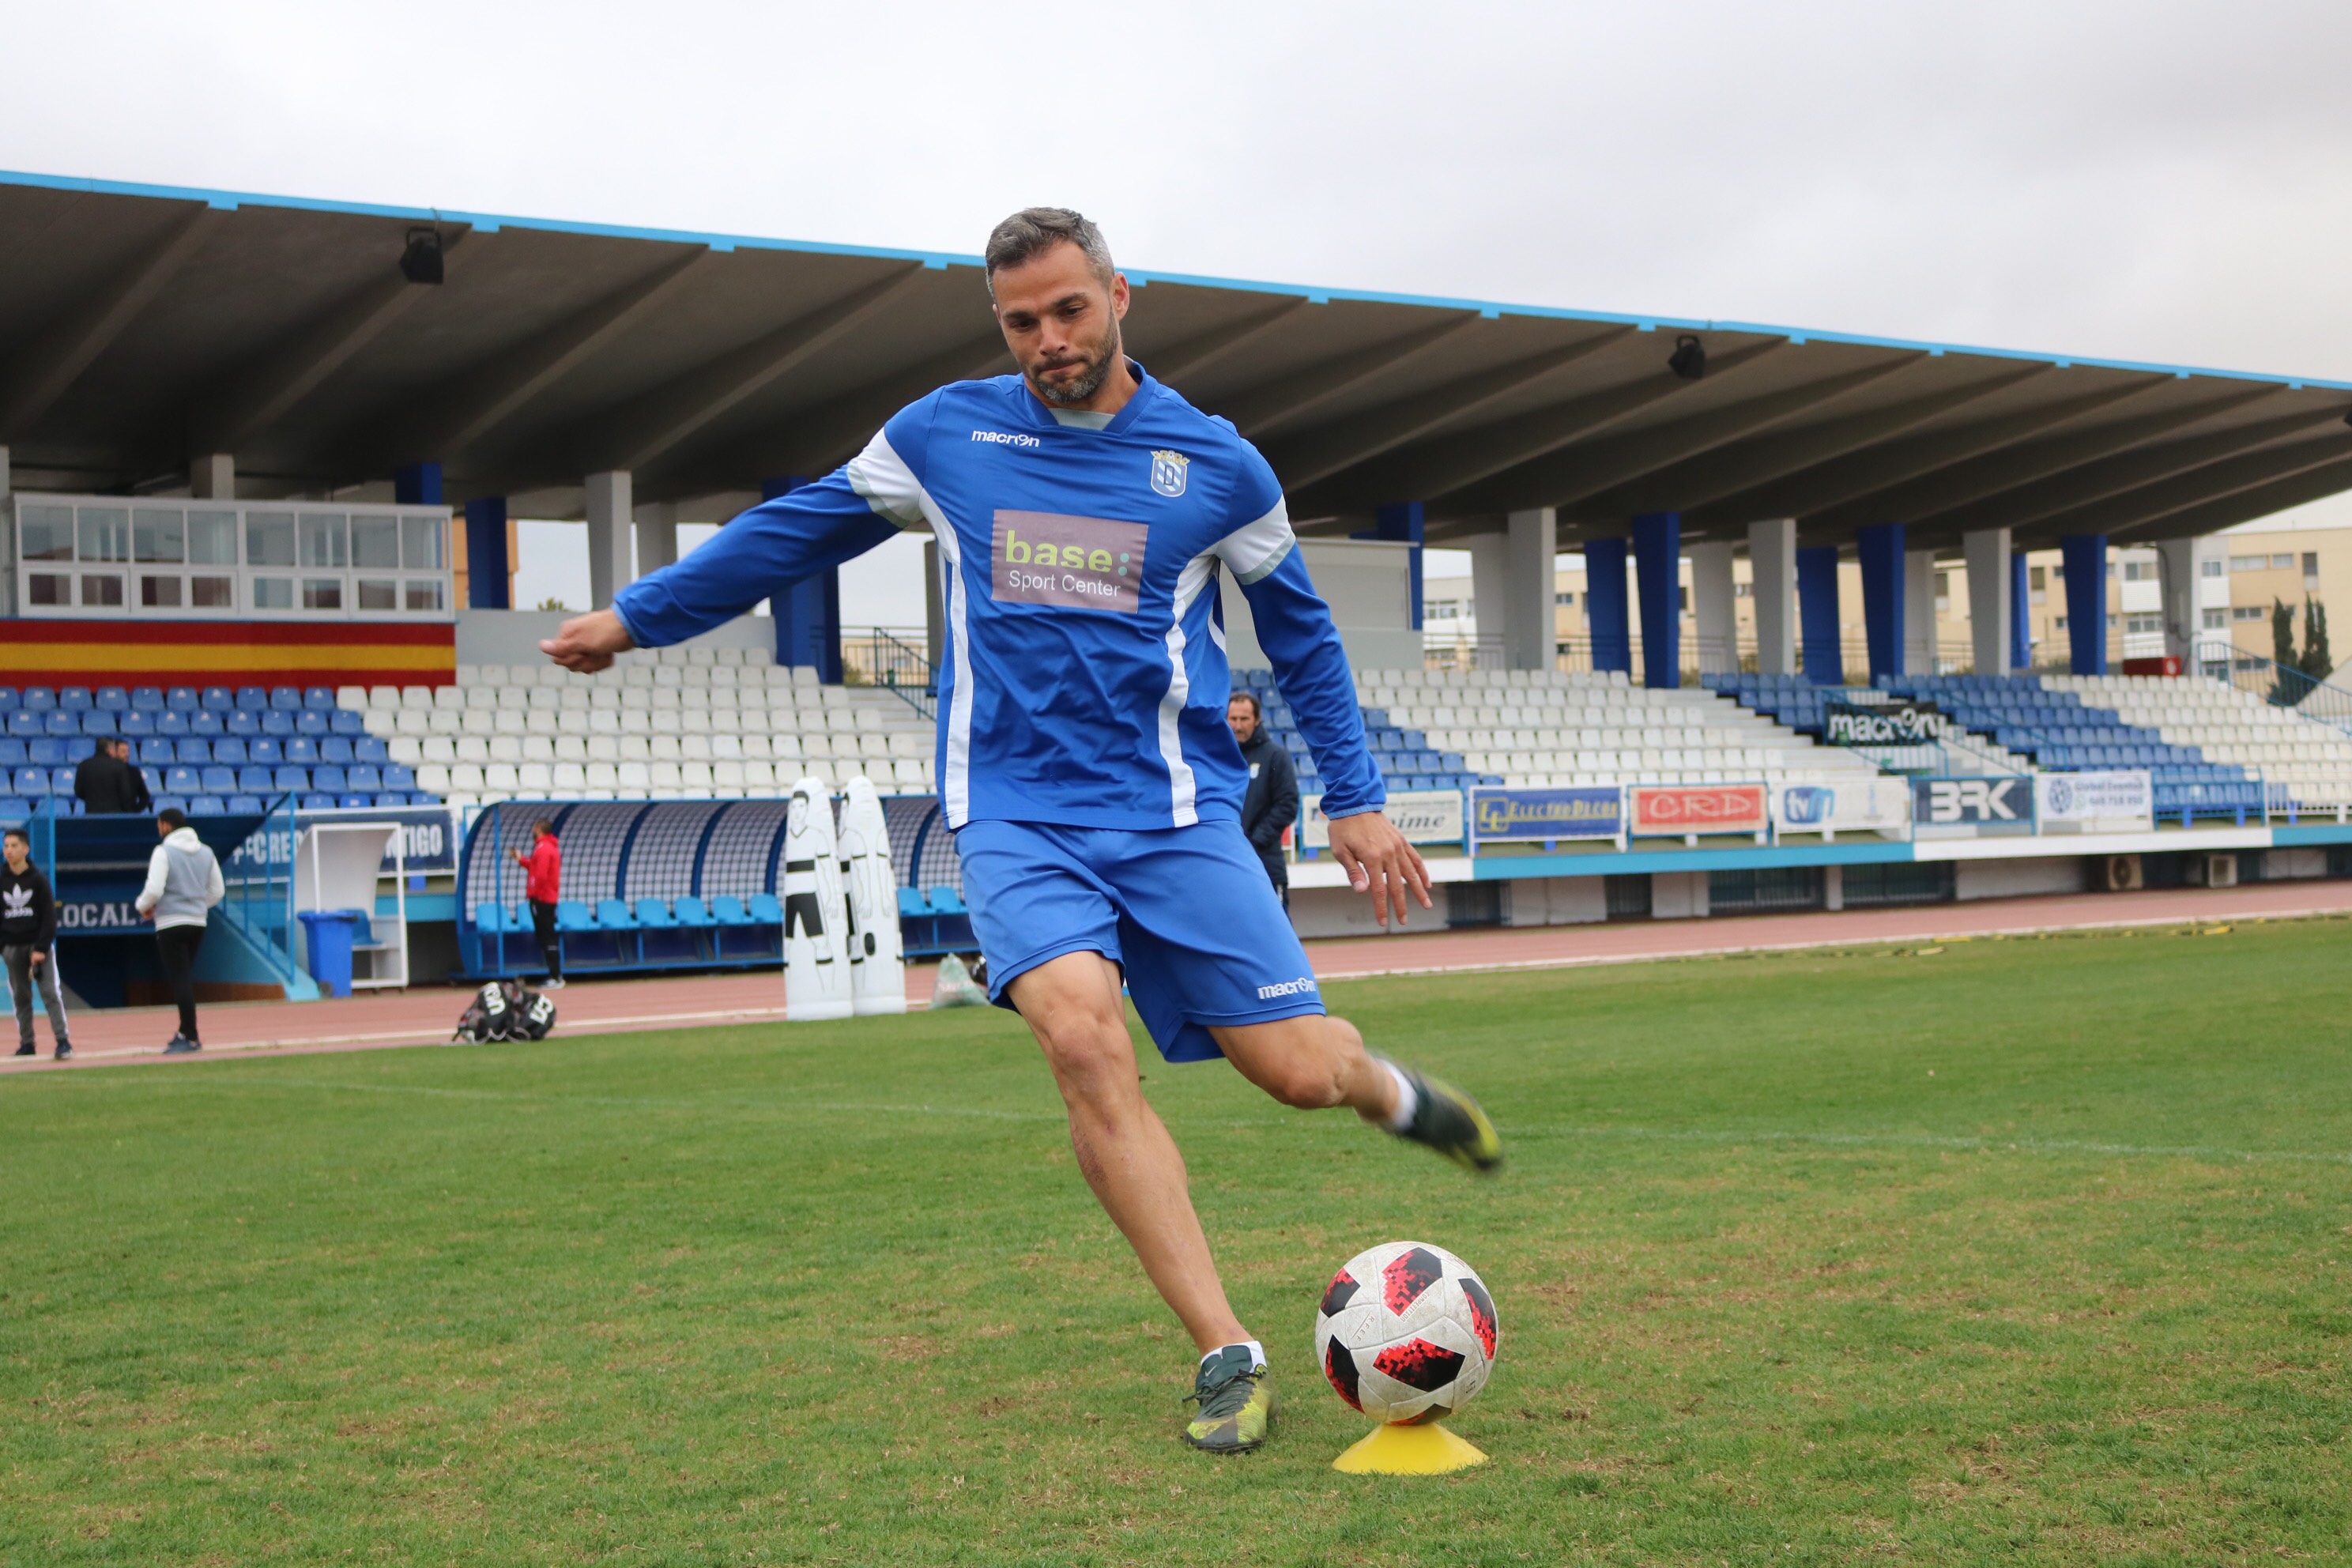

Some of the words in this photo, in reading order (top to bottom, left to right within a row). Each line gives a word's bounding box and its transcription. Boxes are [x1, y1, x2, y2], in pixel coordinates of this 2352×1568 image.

[971, 431, 1040, 447] macron
[1008, 570, 1056, 592] Sport
[1061, 575, 1121, 597] Center
[1649, 793, 1752, 820] CRD
[1931, 779, 2017, 821] BRK
[57, 903, 137, 928] OCAL
[1257, 977, 1316, 1000] macron
[1356, 1315, 1375, 1342] RFEF
